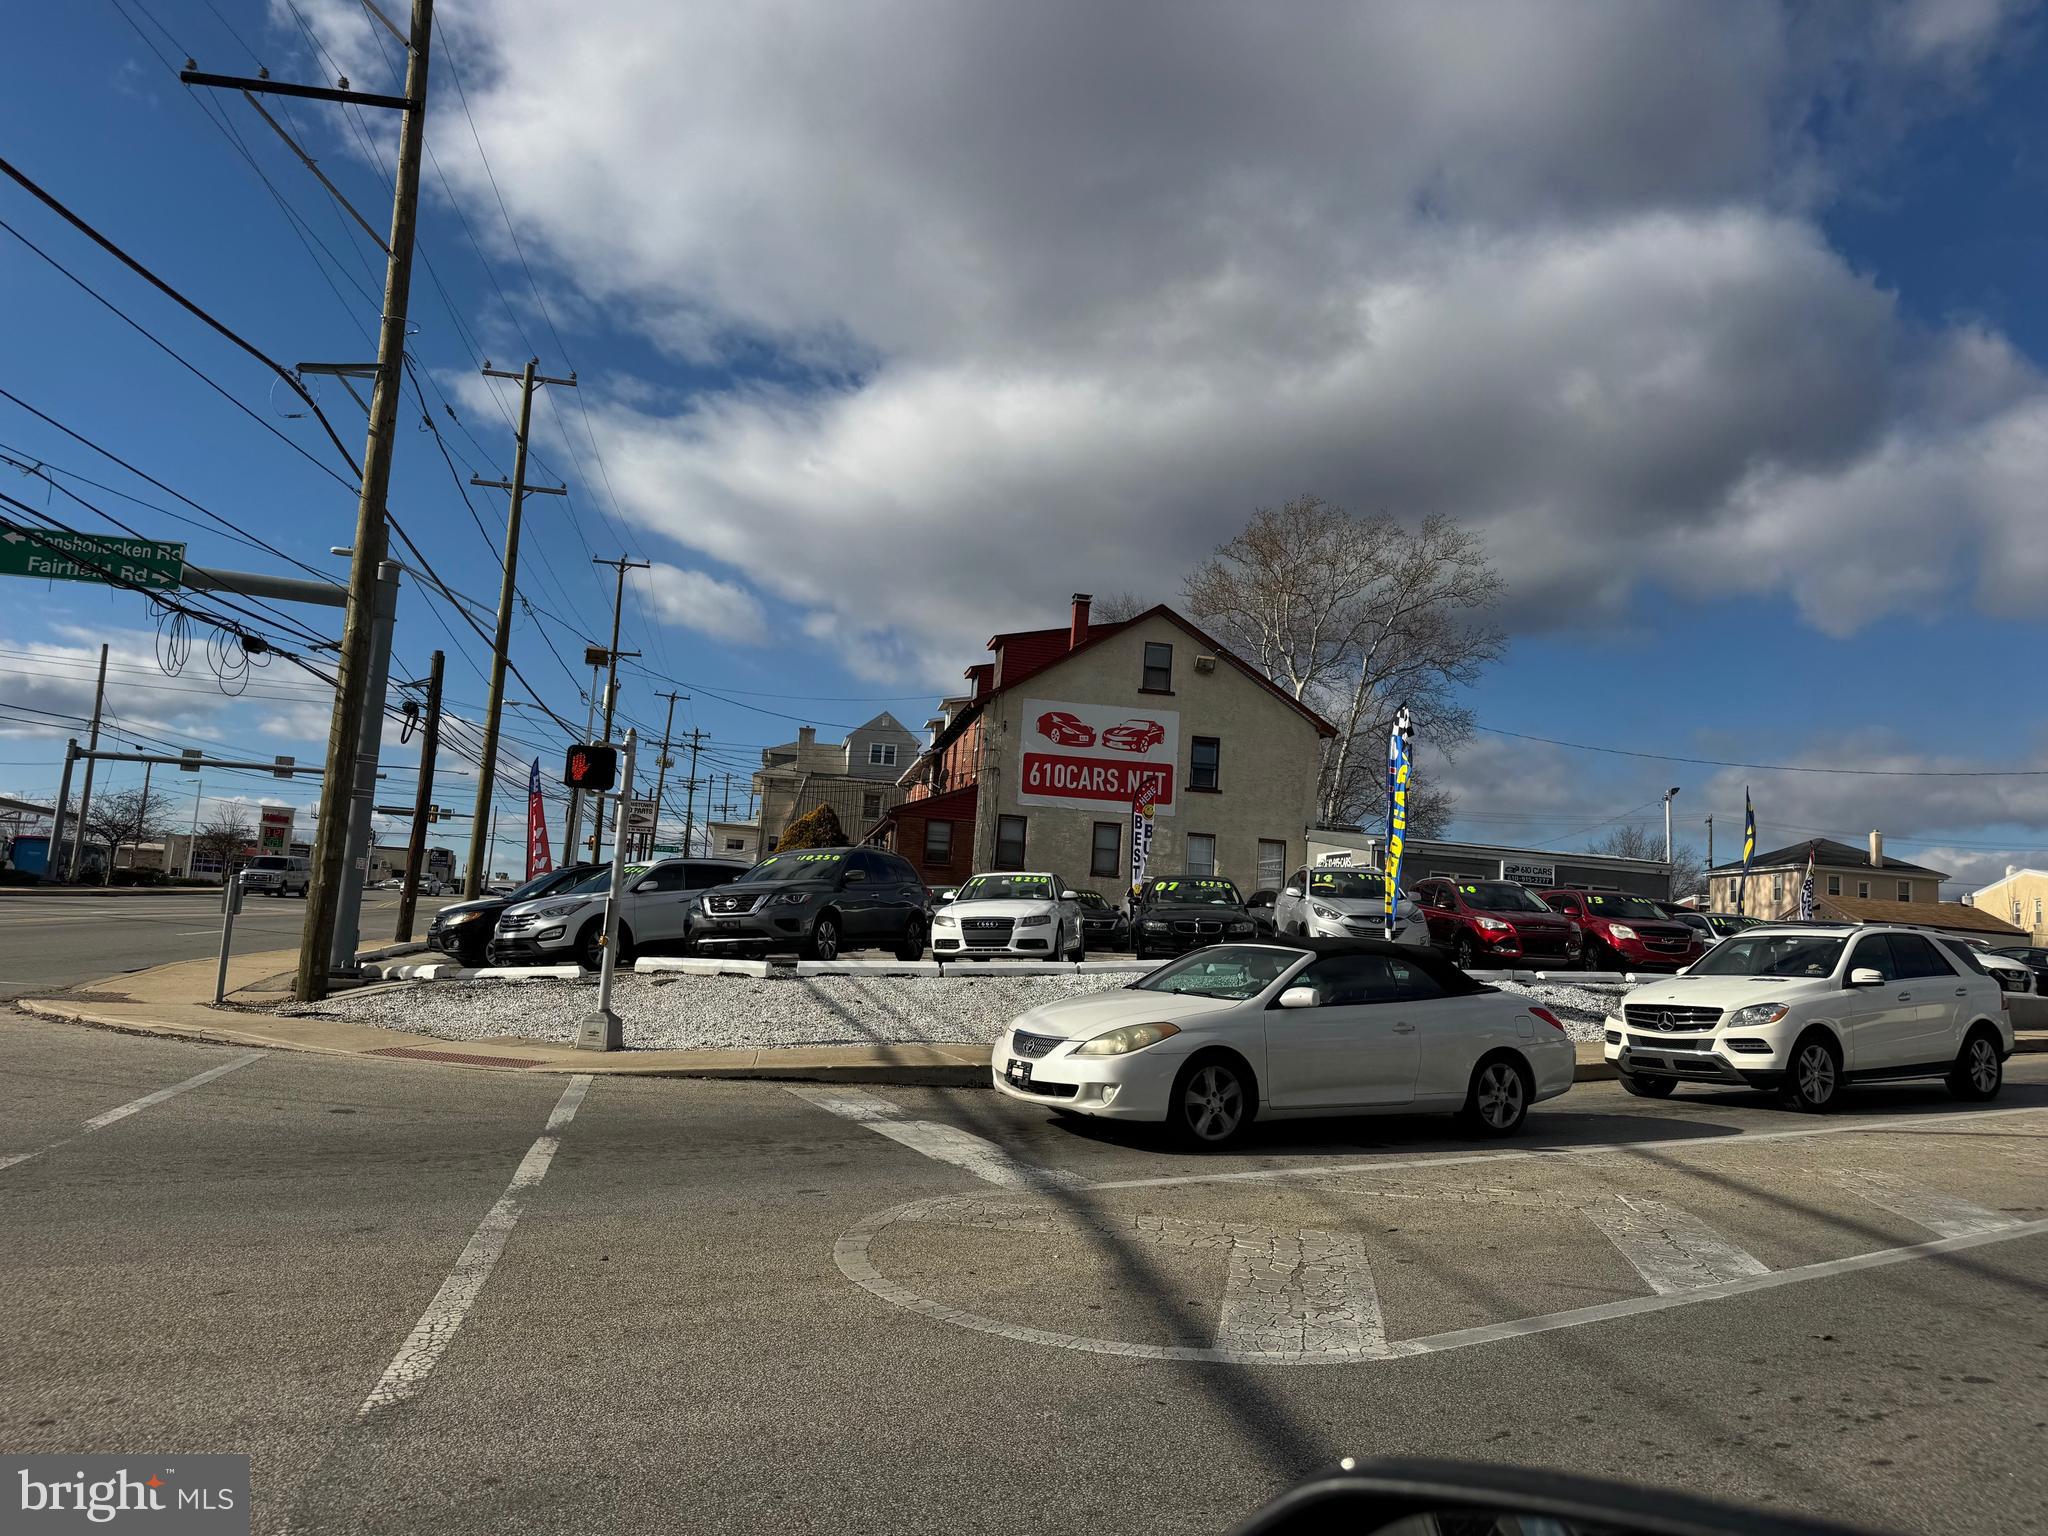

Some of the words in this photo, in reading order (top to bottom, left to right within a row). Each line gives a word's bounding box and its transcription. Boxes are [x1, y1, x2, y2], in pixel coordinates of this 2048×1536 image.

[156, 543, 184, 562] Rd
[121, 566, 149, 584] Rd
[1132, 814, 1143, 880] BEST
[1520, 866, 1532, 875] 610
[1532, 867, 1553, 877] CARS
[969, 877, 987, 887] 11
[1155, 881, 1179, 891] 07
[1587, 896, 1604, 905] 13
[1711, 917, 1726, 926] 11
